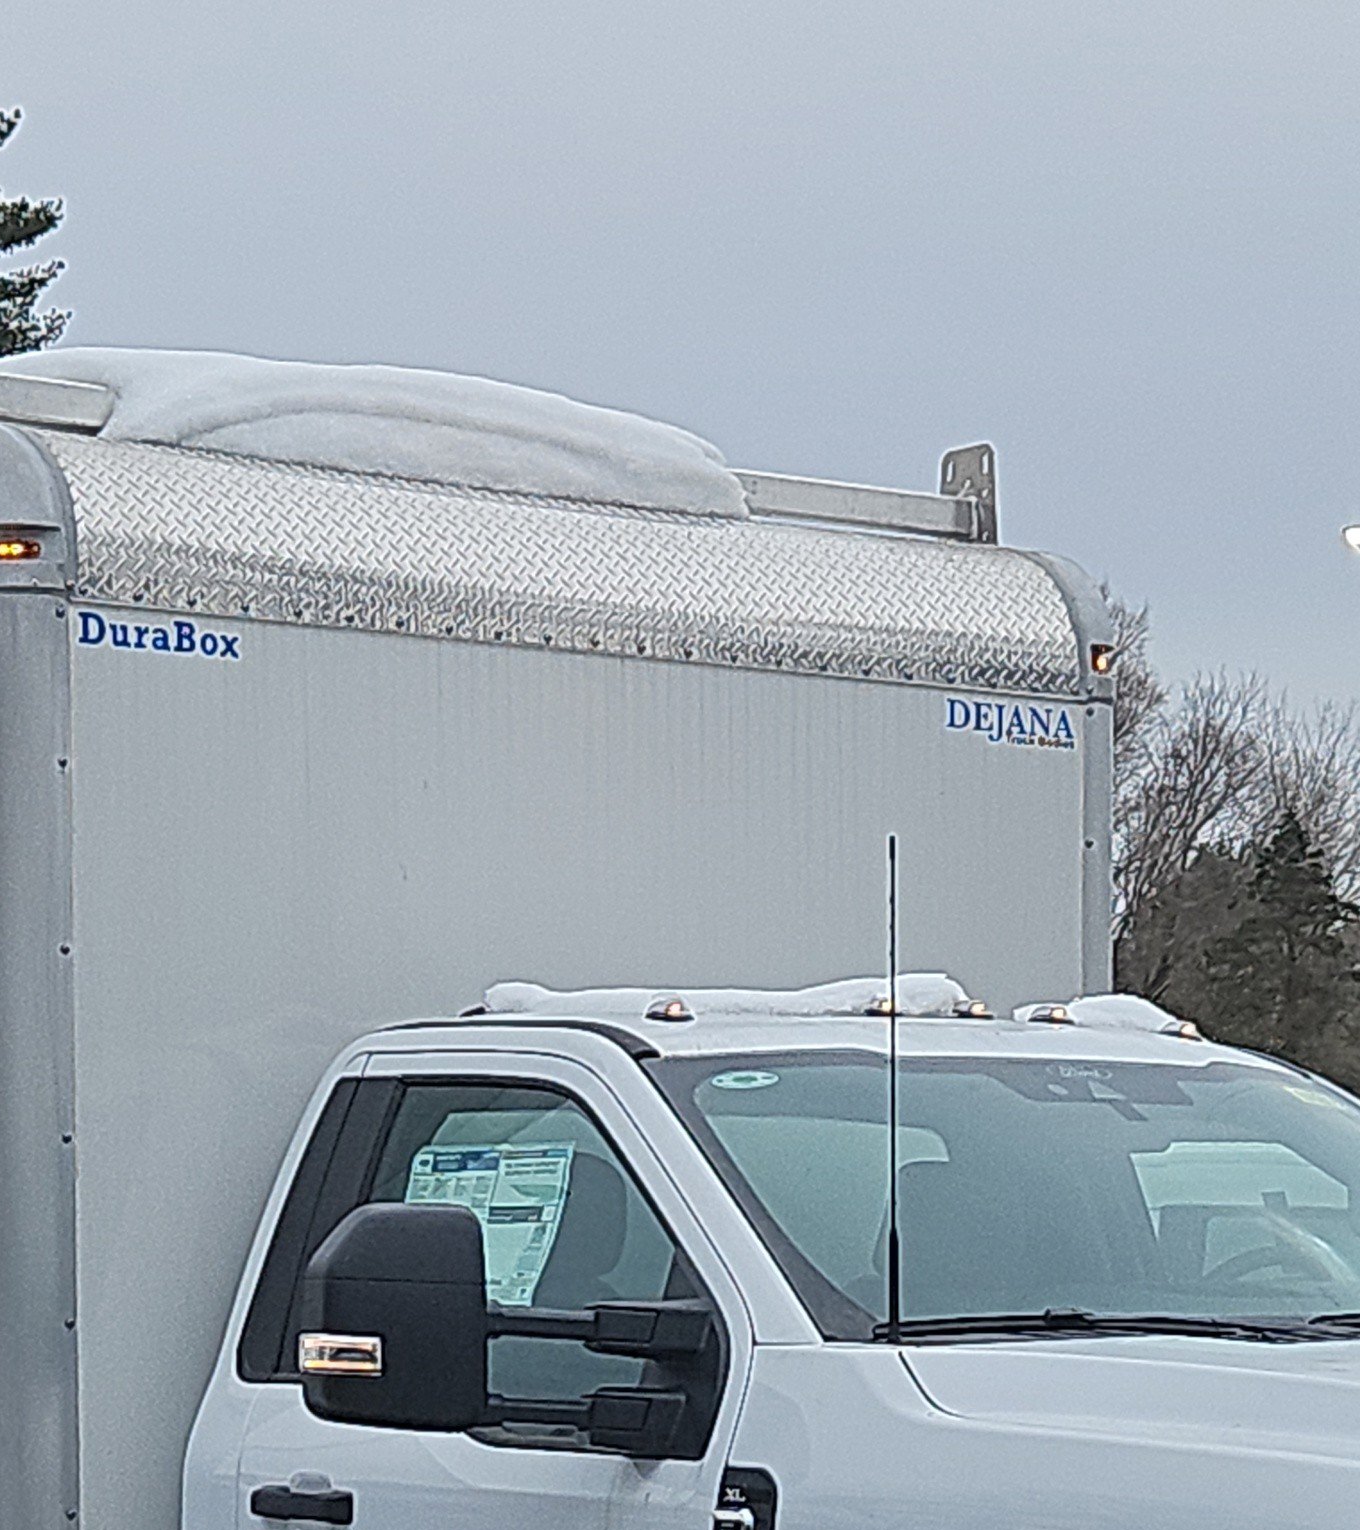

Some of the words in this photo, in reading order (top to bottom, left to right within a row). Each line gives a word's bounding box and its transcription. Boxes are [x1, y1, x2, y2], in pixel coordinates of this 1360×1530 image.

[78, 611, 240, 659] DuraBox
[946, 697, 1074, 742] DEJANA
[722, 1487, 747, 1502] XL
